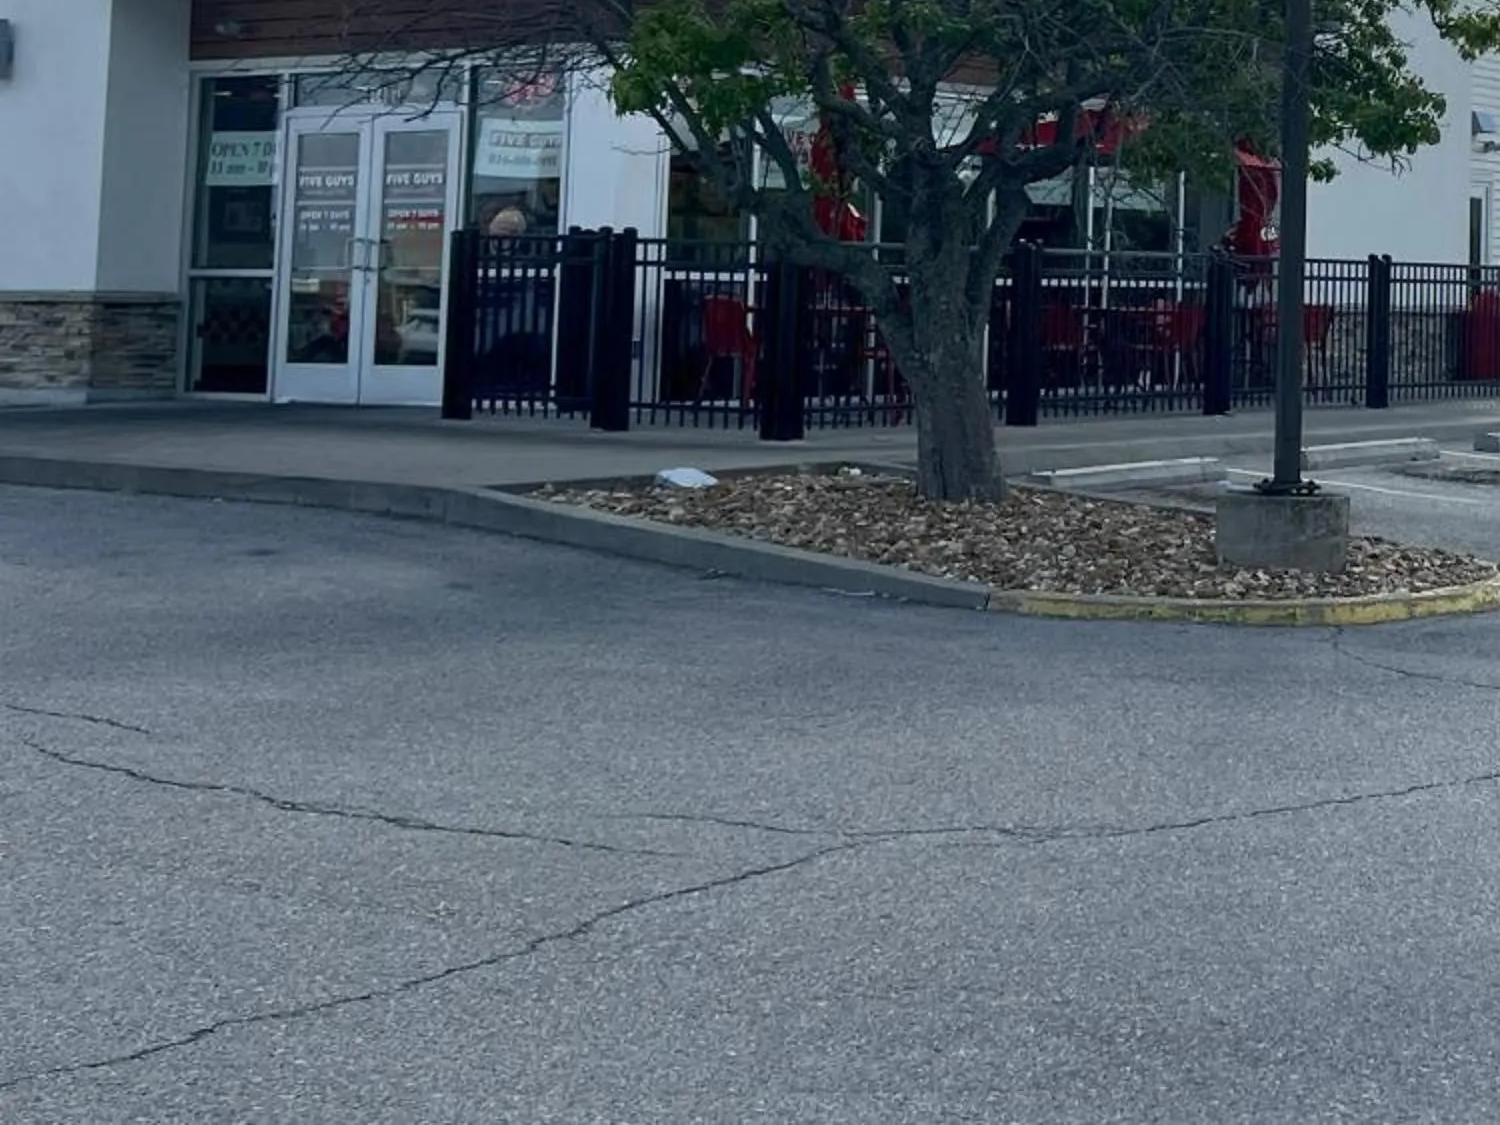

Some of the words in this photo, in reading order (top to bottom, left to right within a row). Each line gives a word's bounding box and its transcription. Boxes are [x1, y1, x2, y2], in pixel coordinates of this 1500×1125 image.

[325, 175, 355, 188] GUYS
[386, 173, 411, 185] FIVE
[413, 172, 443, 185] GUYS
